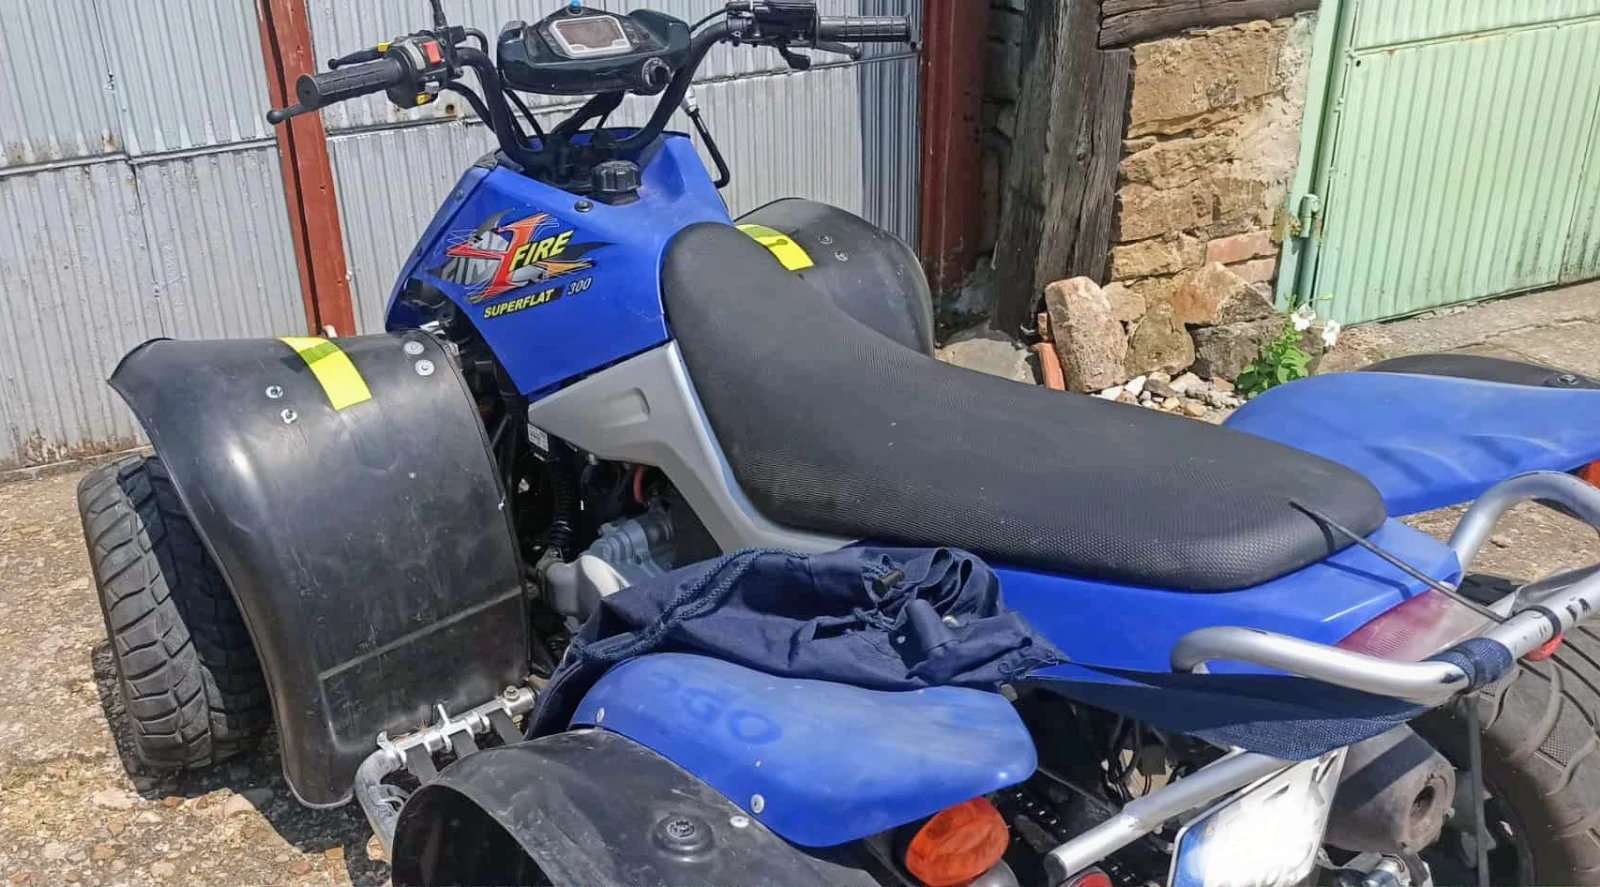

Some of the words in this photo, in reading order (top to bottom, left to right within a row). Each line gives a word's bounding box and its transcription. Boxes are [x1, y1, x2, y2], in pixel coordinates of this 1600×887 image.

[509, 230, 574, 271] FIRE
[484, 288, 555, 318] SUPERFLAT
[567, 277, 592, 296] 300
